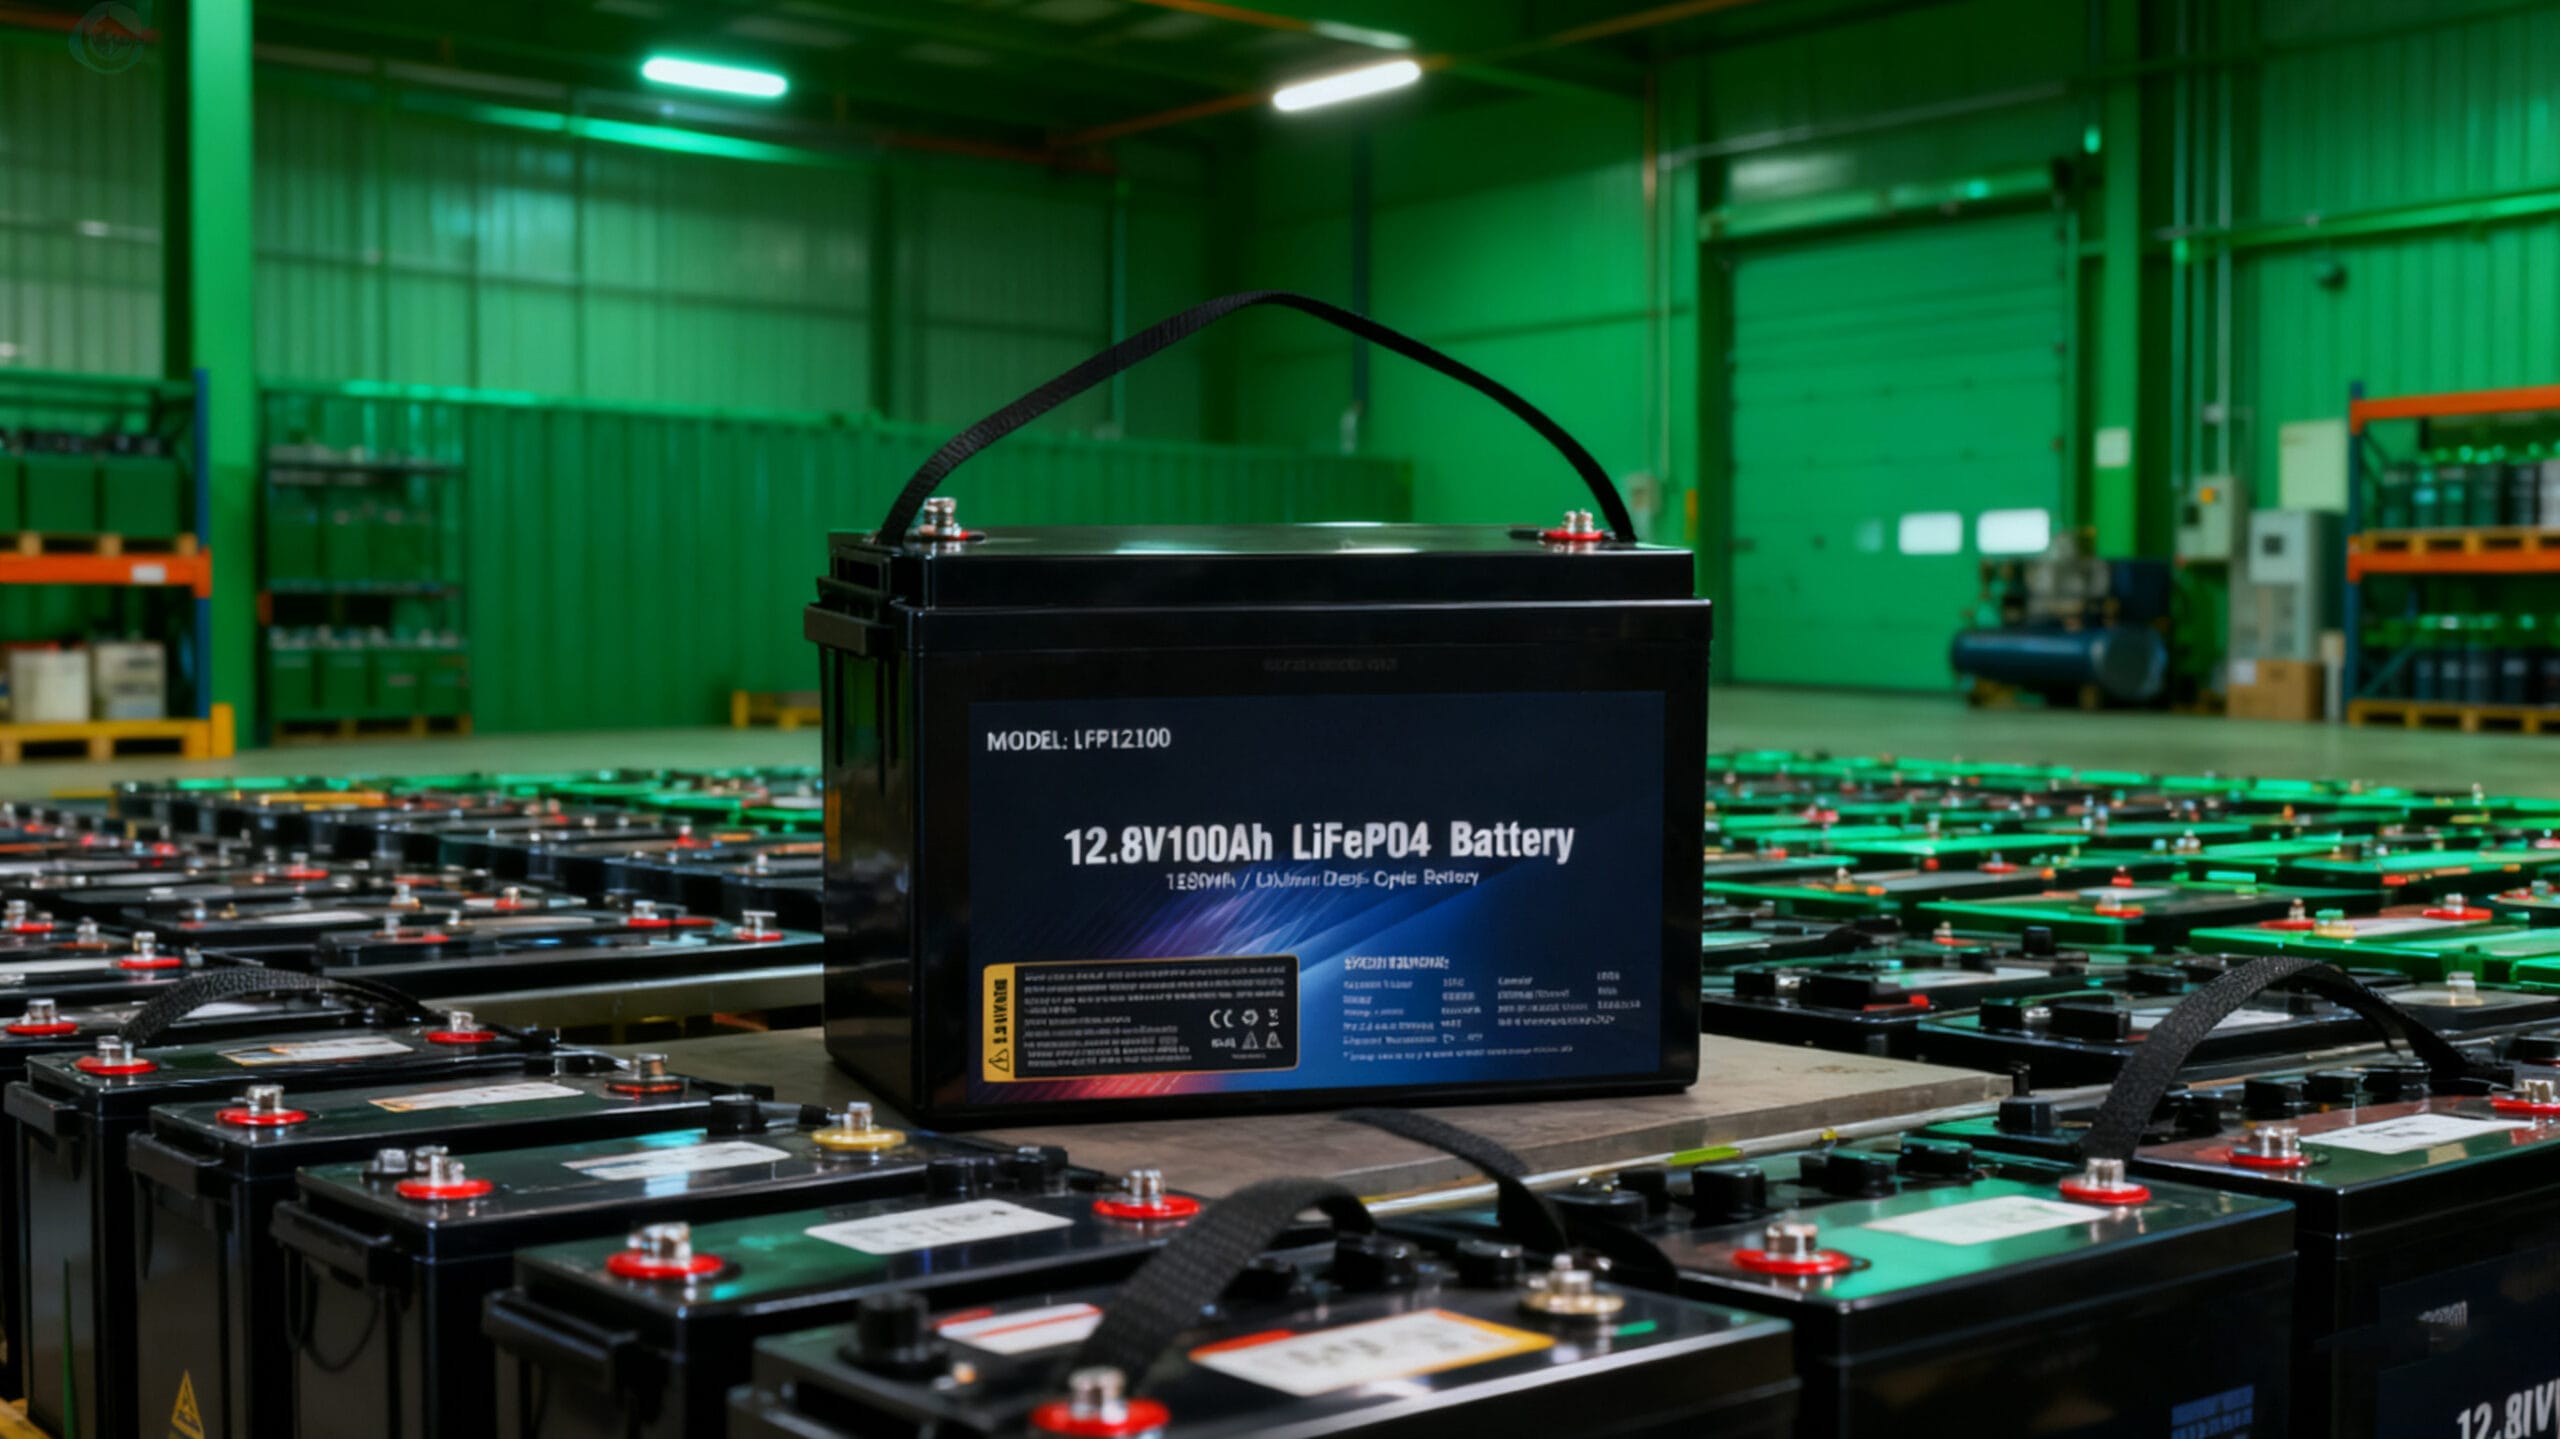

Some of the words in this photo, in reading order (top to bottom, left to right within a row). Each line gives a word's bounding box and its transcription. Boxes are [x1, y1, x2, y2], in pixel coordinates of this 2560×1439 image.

[987, 730, 1068, 751] MODEL:
[1063, 822, 1274, 866] 12.8V100Ah
[1449, 820, 1575, 865] Battery
